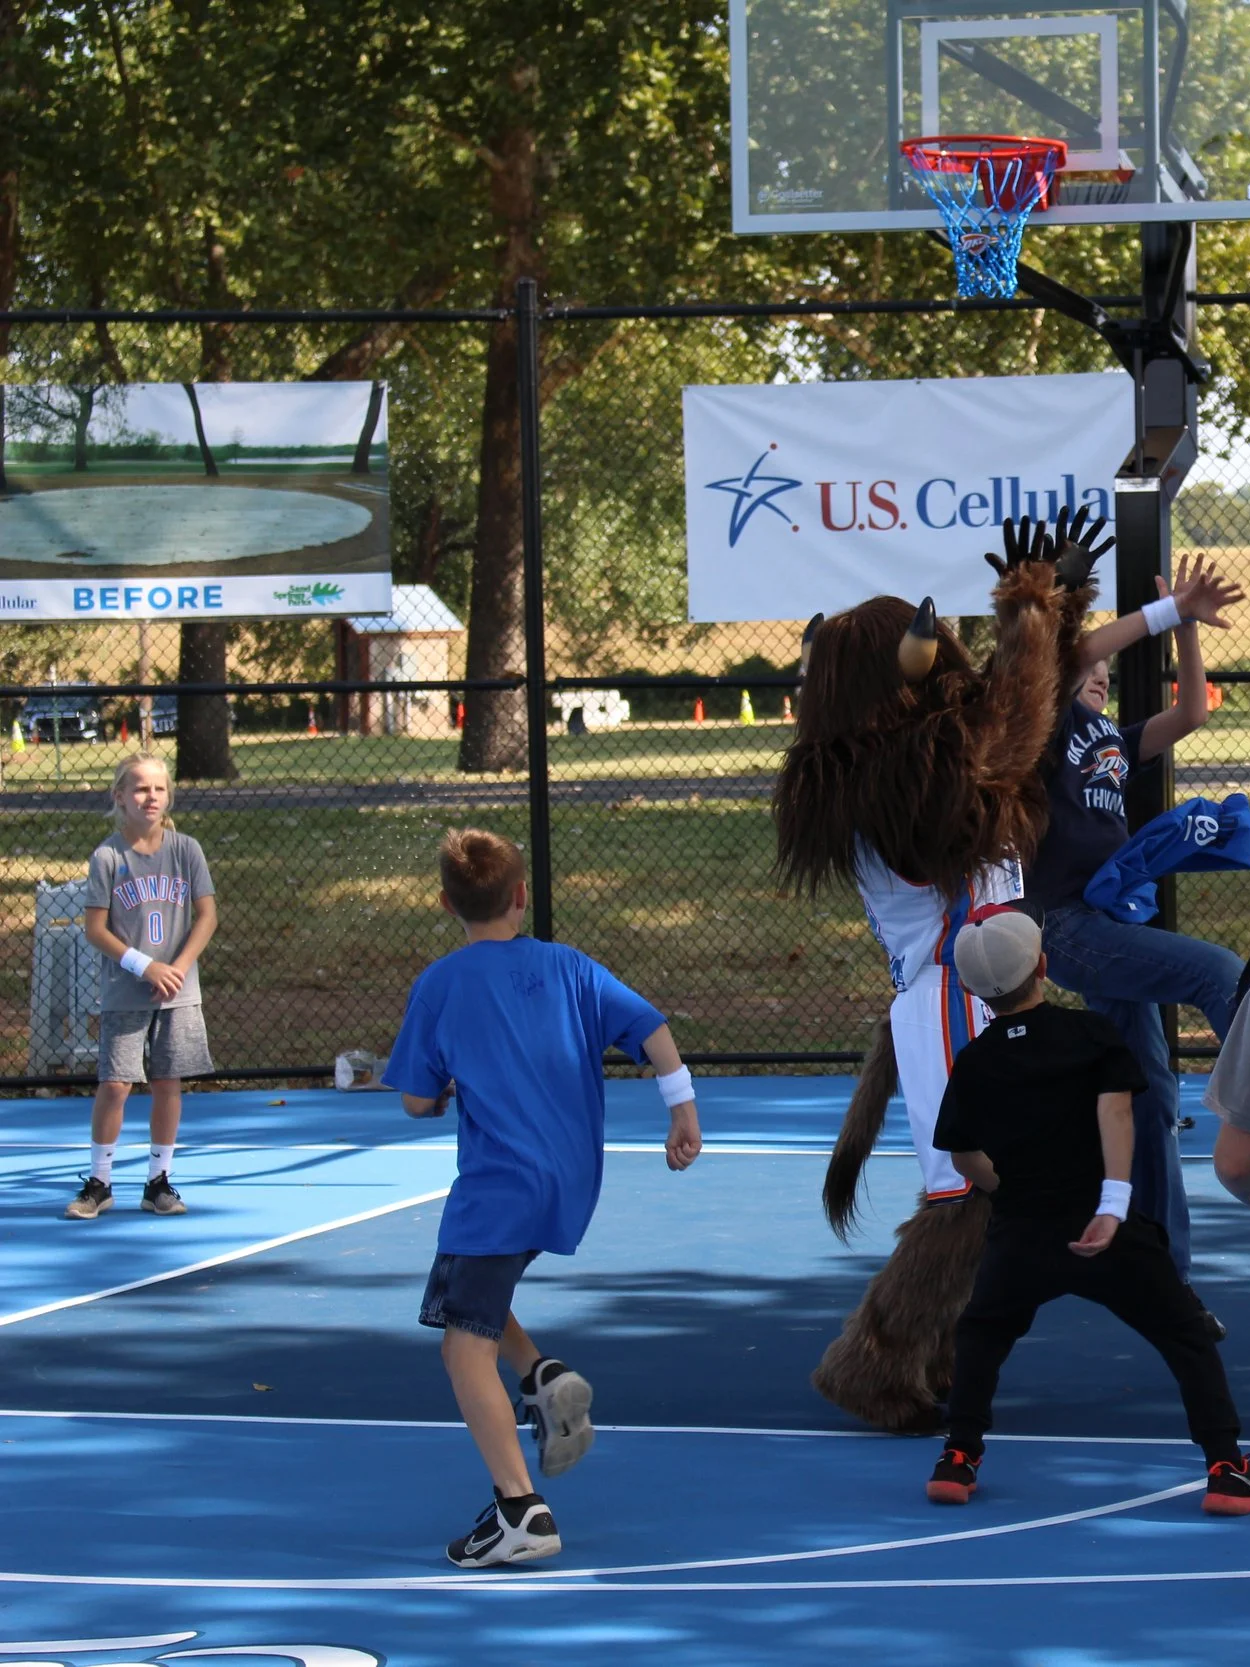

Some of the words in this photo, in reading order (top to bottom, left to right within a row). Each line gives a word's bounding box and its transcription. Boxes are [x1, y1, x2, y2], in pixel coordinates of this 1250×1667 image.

[815, 480, 907, 531] U.S.
[916, 474, 1116, 529] Cellula
[0, 596, 36, 609] lular
[73, 585, 223, 611] BEFORE
[1067, 719, 1124, 765] OKLAHO
[114, 875, 189, 911] THUNDER
[149, 911, 164, 945] 0
